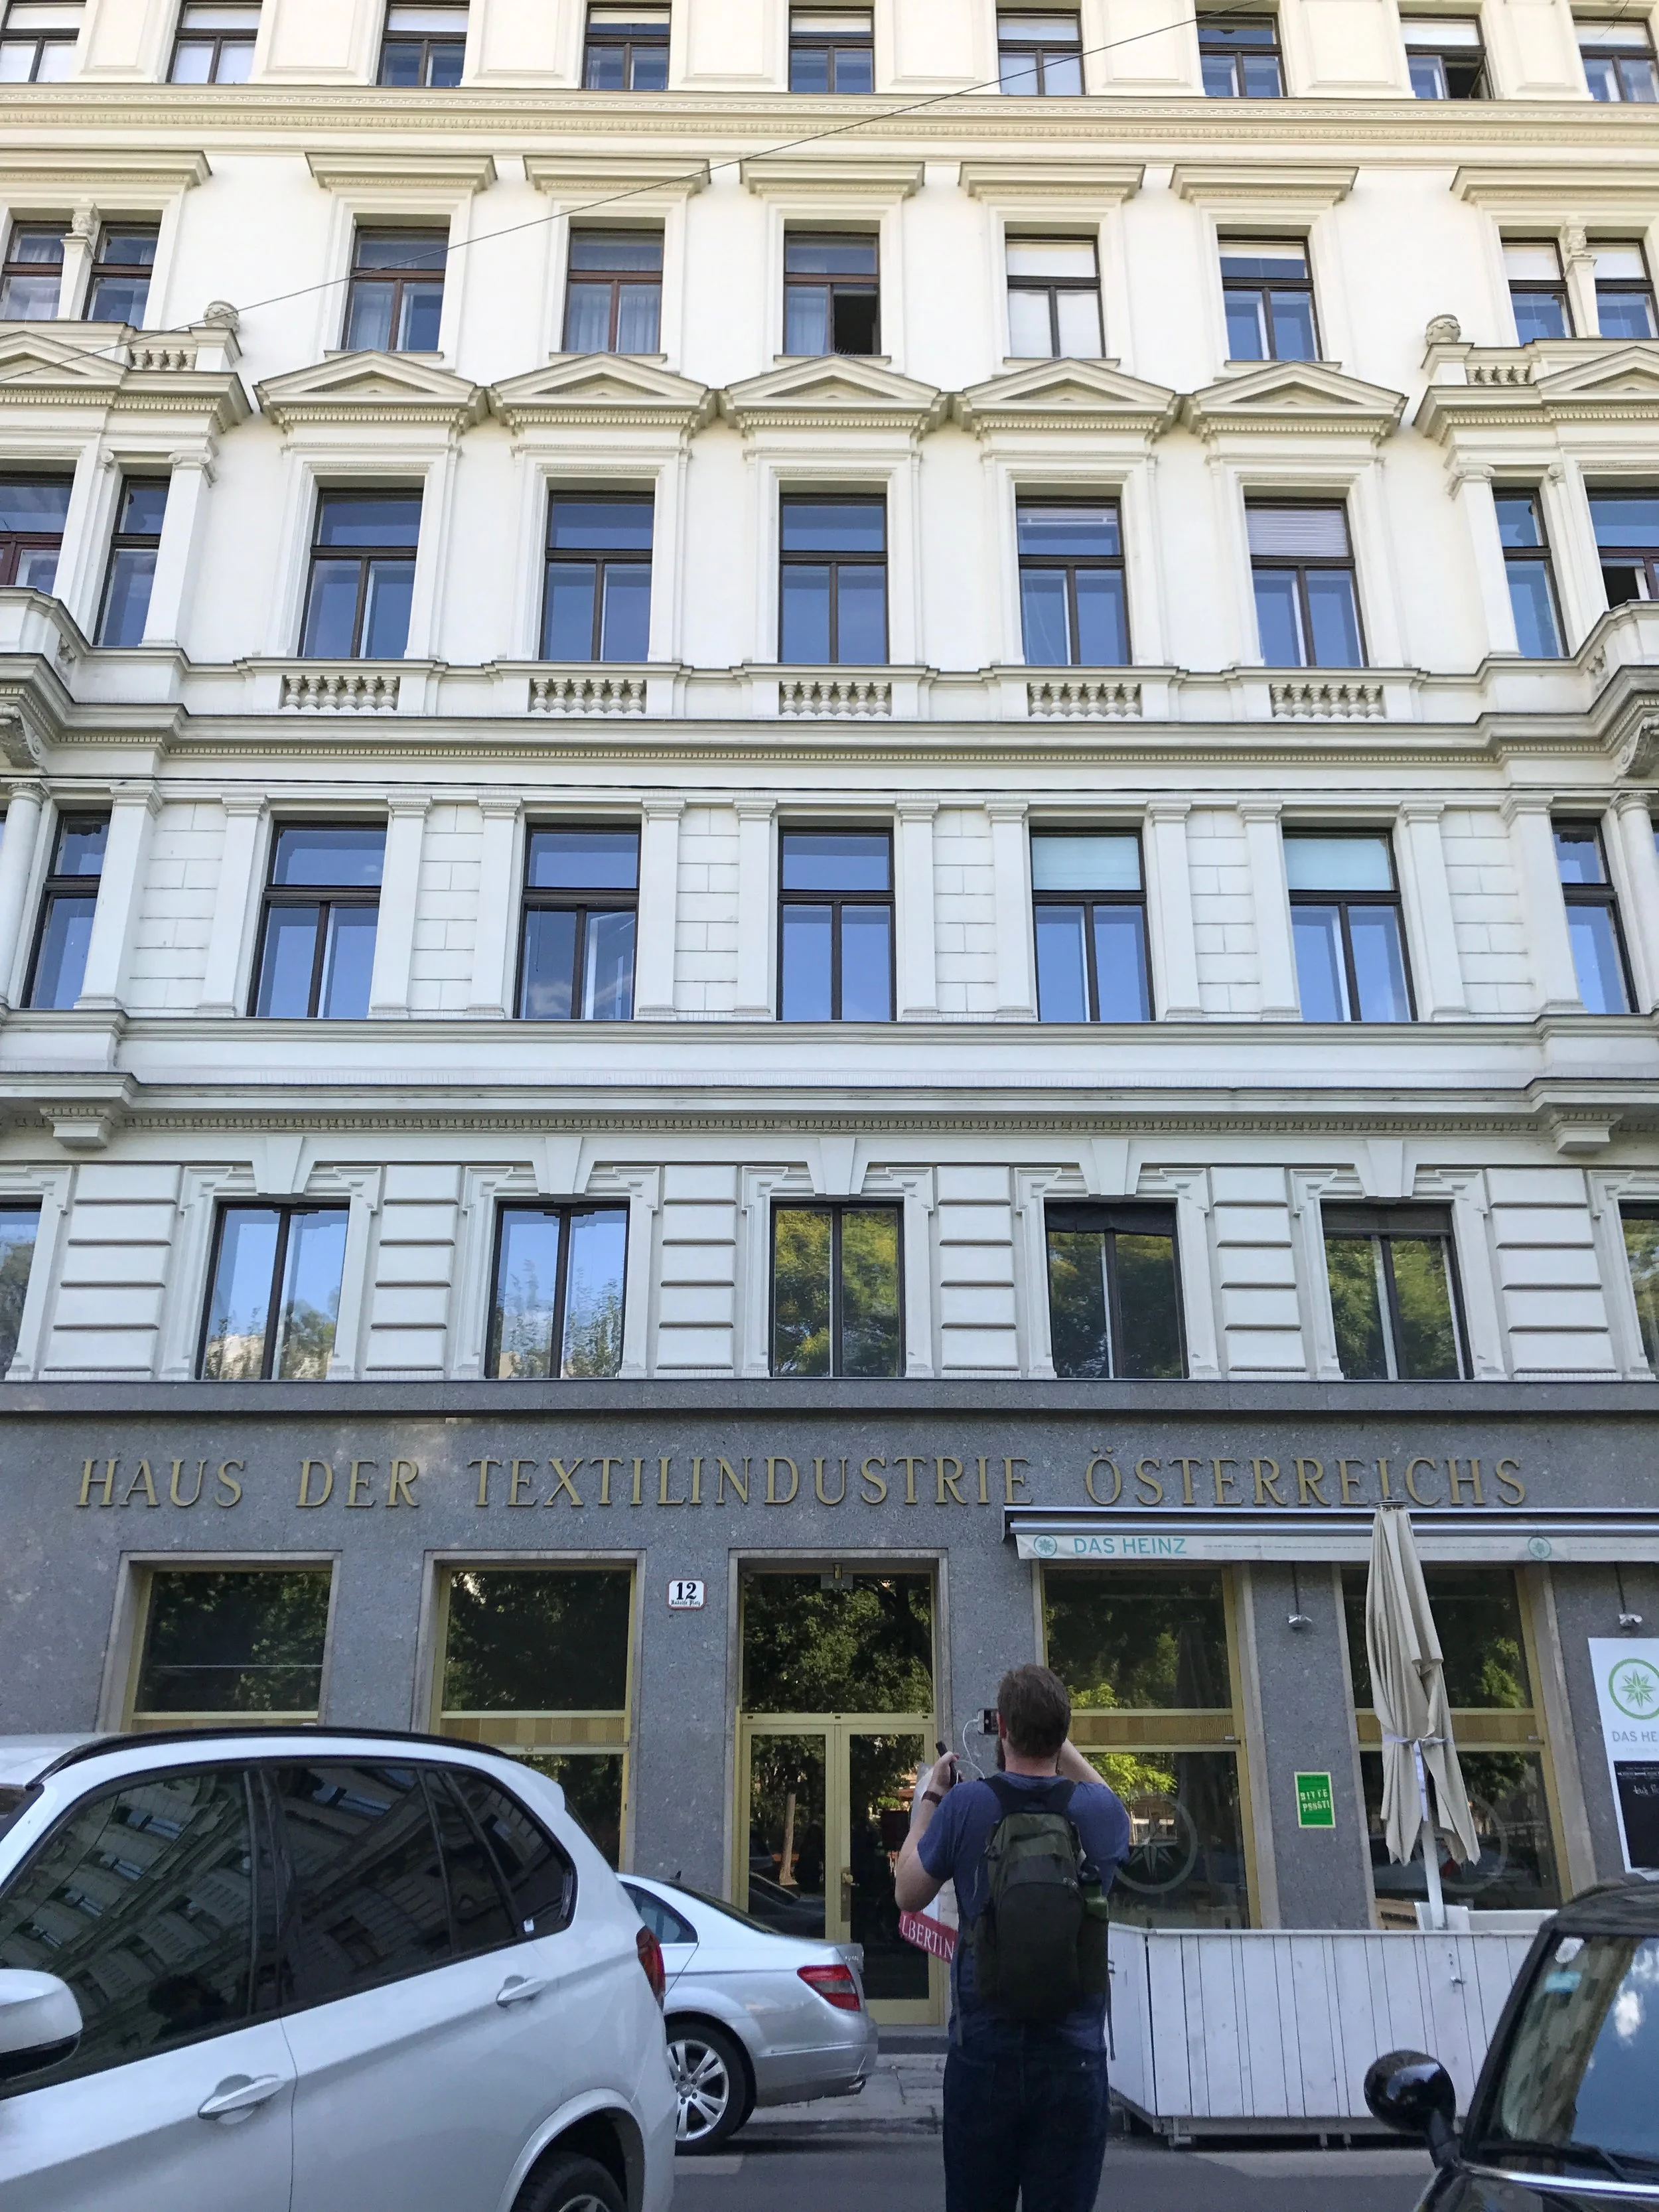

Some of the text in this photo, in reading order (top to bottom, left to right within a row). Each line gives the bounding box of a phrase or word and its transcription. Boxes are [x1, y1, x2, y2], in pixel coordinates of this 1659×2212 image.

[76, 1445, 1526, 1507] HAUS DER TEXTILINDUSTRIE ÖSTERREICHS
[1073, 1538, 1116, 1554] DAS
[1122, 1538, 1187, 1554] HEINZ
[676, 1582, 697, 1600] 12
[1612, 1731, 1659, 1742] DAS HE
[1300, 1789, 1328, 1801] BITTE
[901, 1915, 955, 1960] LBERTIN
